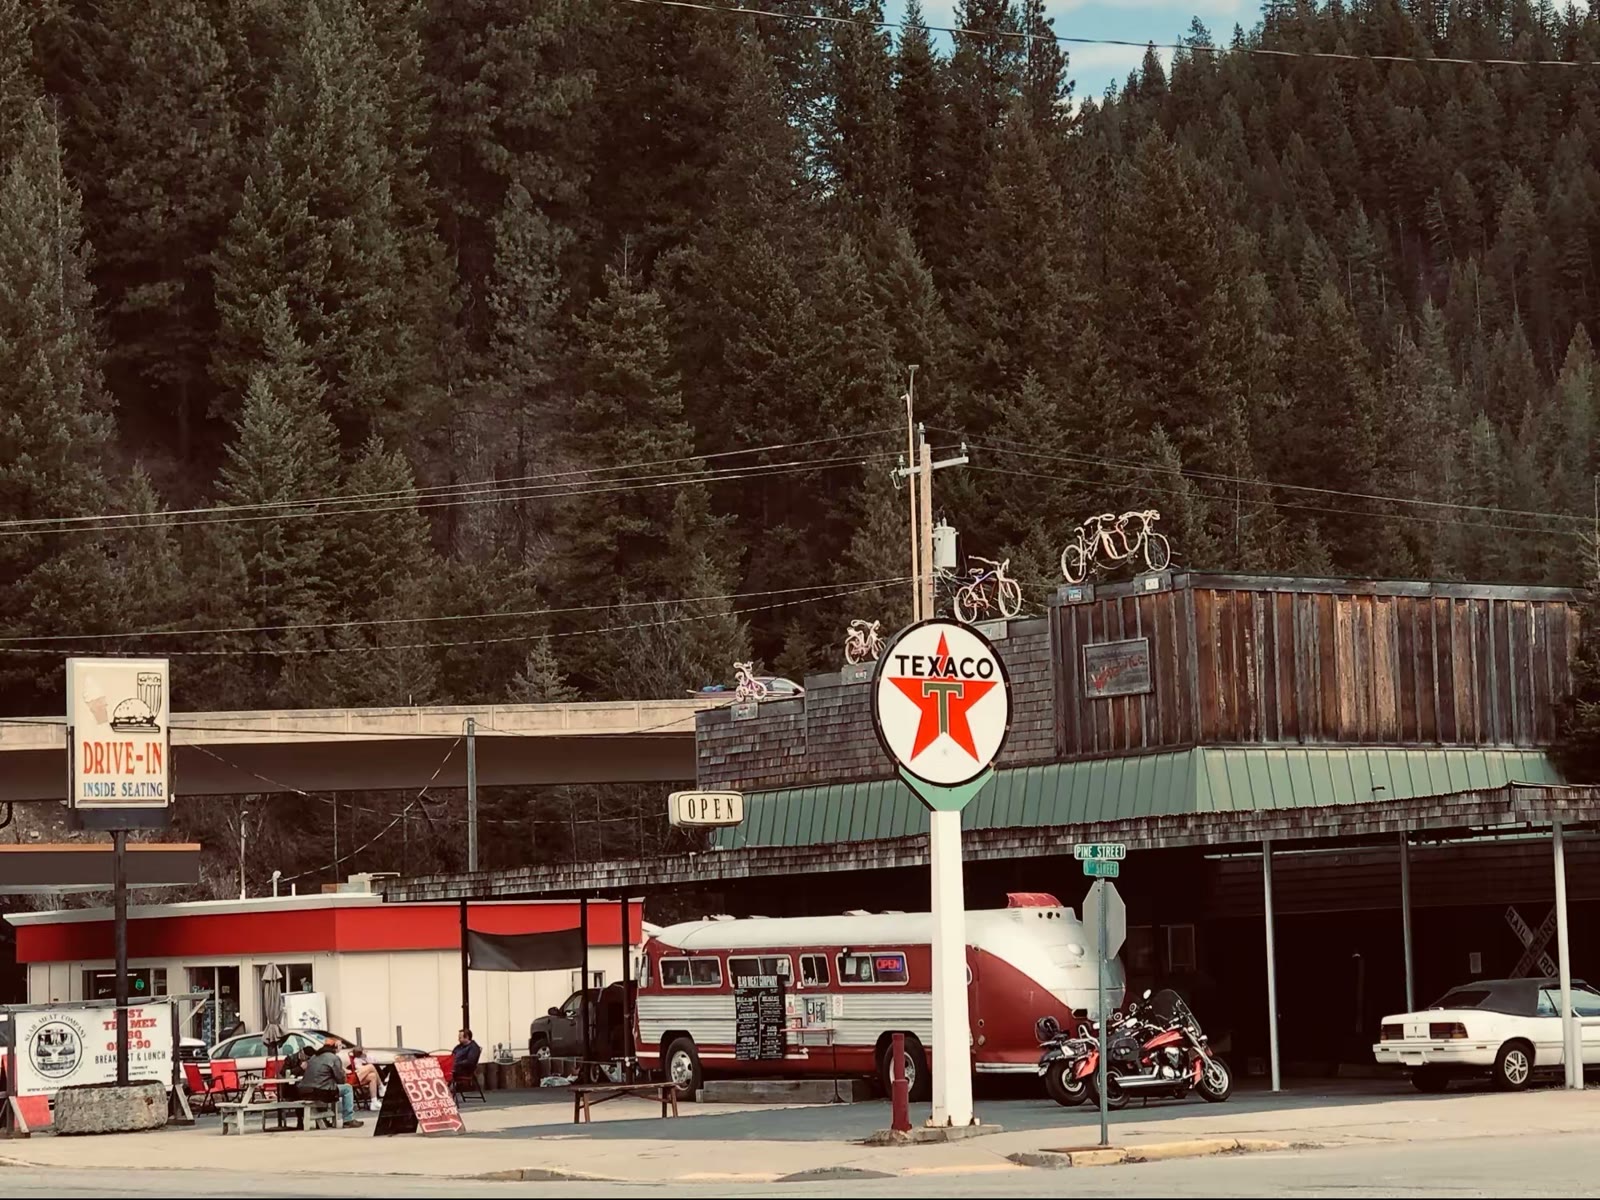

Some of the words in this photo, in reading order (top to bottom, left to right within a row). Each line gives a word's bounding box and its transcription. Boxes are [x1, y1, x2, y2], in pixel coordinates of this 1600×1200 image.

[895, 654, 994, 679] TEXACO
[922, 680, 964, 735] T
[83, 741, 162, 774] DRIVE-IN
[83, 782, 116, 797] INSIDE
[121, 782, 163, 797] SEATING
[688, 798, 733, 819] OPEN
[1076, 846, 1093, 858] PINE
[1097, 846, 1124, 858] STREET
[1096, 863, 1117, 875] STREET
[1506, 908, 1527, 943] RAIL
[1540, 956, 1559, 978] RO
[876, 958, 900, 970] OPEN
[38, 1013, 57, 1024] MEAT
[61, 1014, 87, 1039] COMPANY
[130, 1018, 157, 1029] MEX
[144, 1050, 166, 1061] LUNCH
[399, 1071, 421, 1082] REAL
[420, 1068, 444, 1080] GOOD
[405, 1078, 450, 1102] BBQ
